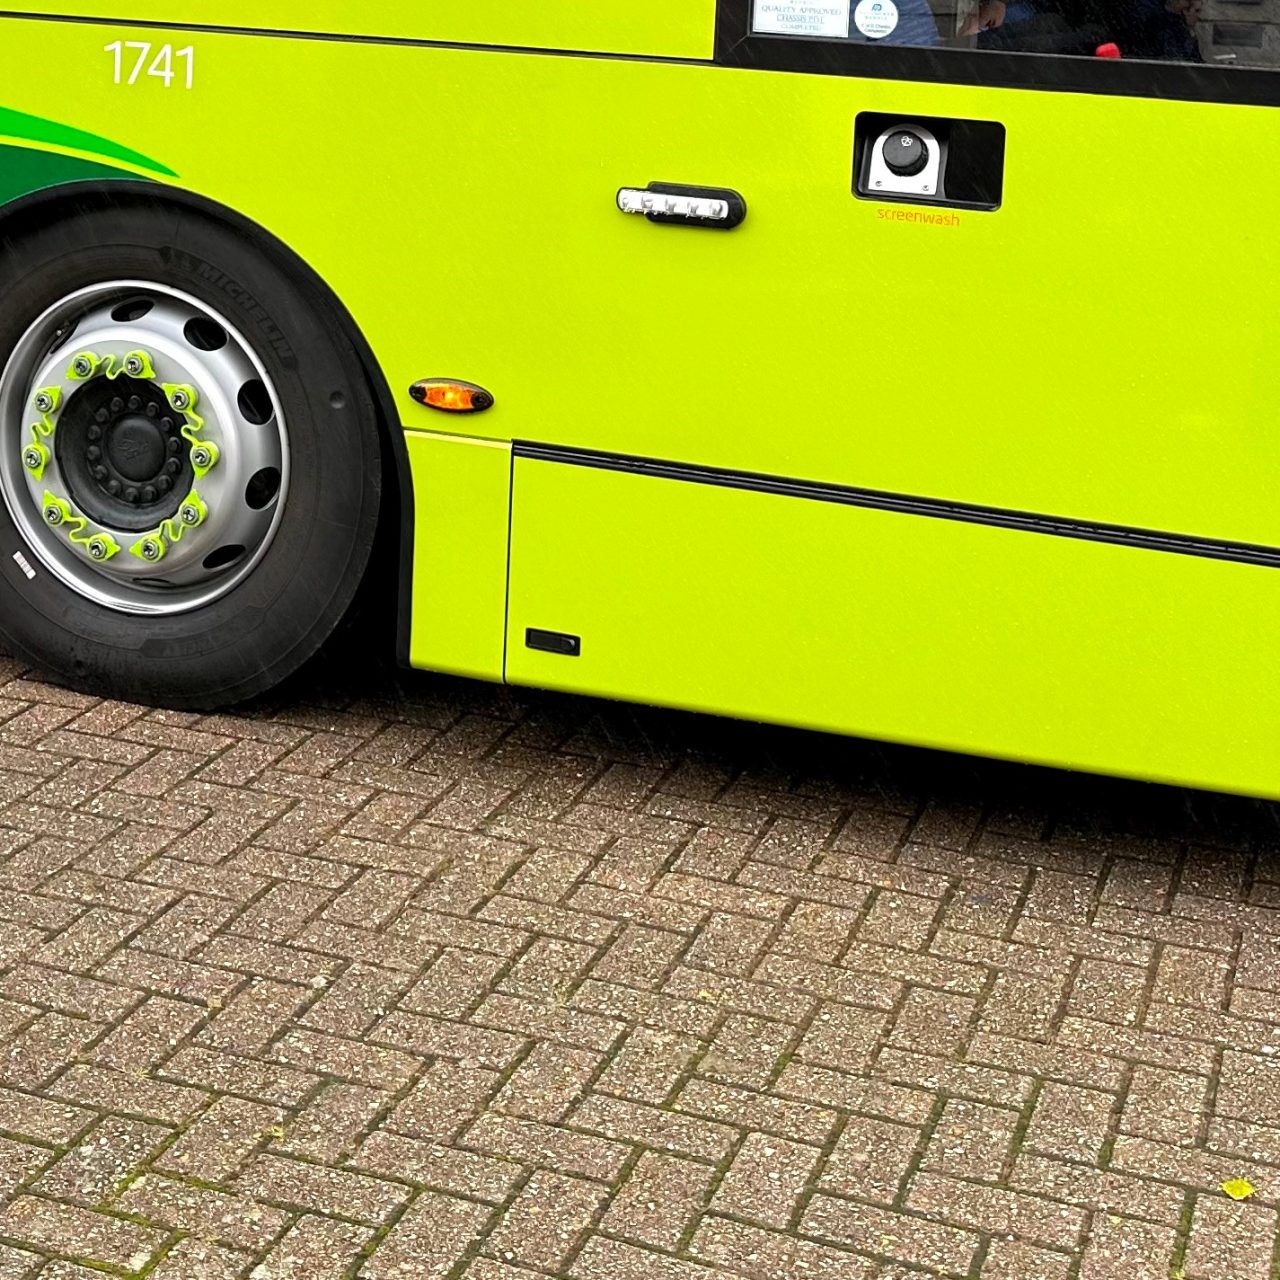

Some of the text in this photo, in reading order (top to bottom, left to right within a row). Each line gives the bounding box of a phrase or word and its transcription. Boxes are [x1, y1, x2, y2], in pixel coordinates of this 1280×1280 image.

[104, 40, 194, 90] 1741
[876, 207, 961, 227] screenwash
[196, 259, 294, 362] MICHELIN
